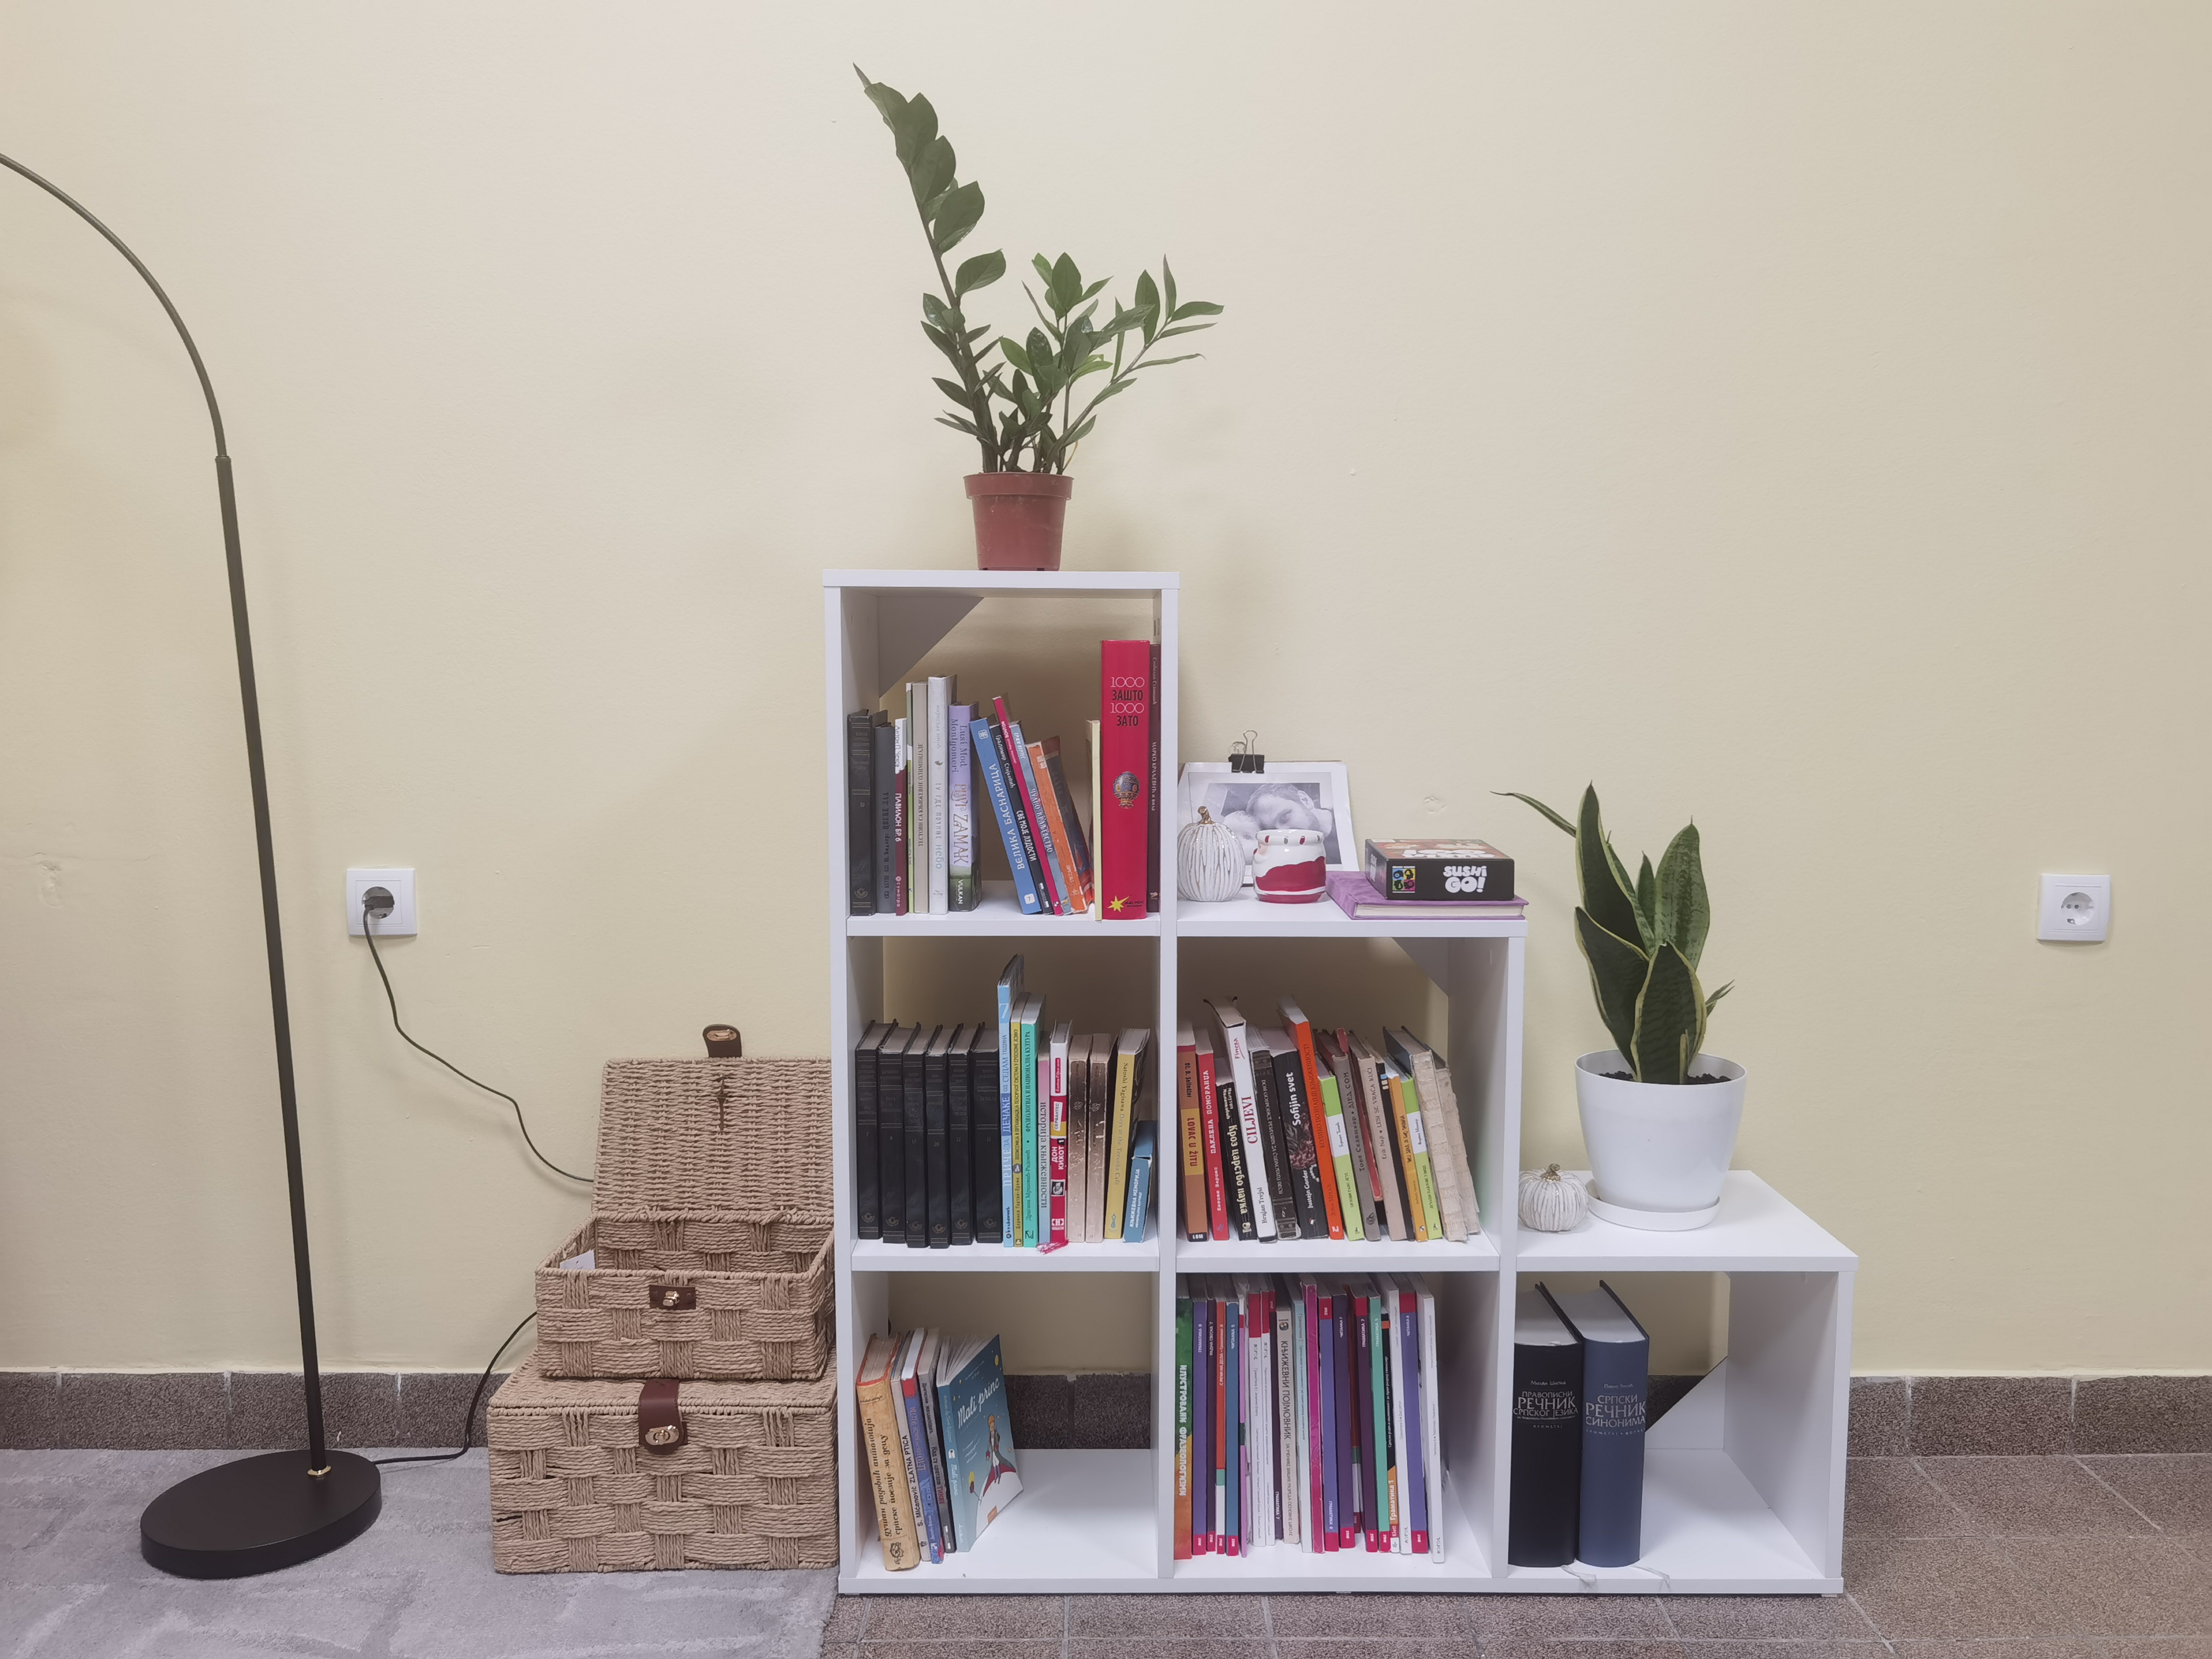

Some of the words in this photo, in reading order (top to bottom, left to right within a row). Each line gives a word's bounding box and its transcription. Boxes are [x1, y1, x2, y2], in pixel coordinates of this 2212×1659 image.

[1110, 677, 1145, 688] 1000
[1112, 690, 1143, 701] ЗАШТО
[1110, 703, 1145, 714] 1000
[1116, 716, 1138, 726] ЗАТО
[949, 718, 959, 774] Montgomeri
[959, 725, 968, 745] Lusi
[959, 748, 968, 767] Mod
[989, 763, 1013, 825] БАСНАРИЦА
[953, 813, 968, 864] ZAMAK
[1007, 829, 1025, 870] ВЕЛИКА
[1022, 835, 1036, 861] ЛУДОСТИ
[1445, 876, 1485, 893] GO!
[1203, 1070, 1212, 1115] ПОМОРАНЏА
[1285, 1072, 1295, 1092] svet
[1120, 1085, 1128, 1111] Yagisawa
[1290, 1094, 1301, 1126] Sofijin
[1002, 1096, 1011, 1132] ДЕЧАКЕ
[1242, 1096, 1258, 1144] CILJEVI
[1208, 1119, 1216, 1154] ПАКЛЕНА
[1228, 1124, 1238, 1147] Кроз
[1189, 1150, 1198, 1166] ŽITU
[1231, 1149, 1245, 1186] царство
[1303, 1170, 1311, 1189] Gorder
[1237, 1188, 1248, 1214] наука
[1281, 1340, 1290, 1388] КЊИЖЕВНИ
[957, 1396, 977, 1429] Mali
[977, 1378, 1000, 1412] princ
[1179, 1365, 1188, 1422] ИЛУСТРОВАНИ
[1518, 1396, 1576, 1410] РЕЧНИК
[1597, 1394, 1637, 1404] СРПСКИ
[1282, 1390, 1291, 1439] ПОЈМОВНИК
[1513, 1408, 1549, 1417] СРПСКОГ
[1553, 1407, 1578, 1418] ЈЕЗИКА
[1586, 1401, 1646, 1418] РЕЧНИК
[1586, 1415, 1645, 1428] СИНОНИМА
[902, 1435, 911, 1455] PTICA
[906, 1456, 916, 1483] ZLATNA
[1179, 1426, 1187, 1496] ФРАЗЕОЛОГИЗМИ
[911, 1486, 921, 1518] Mićanović
